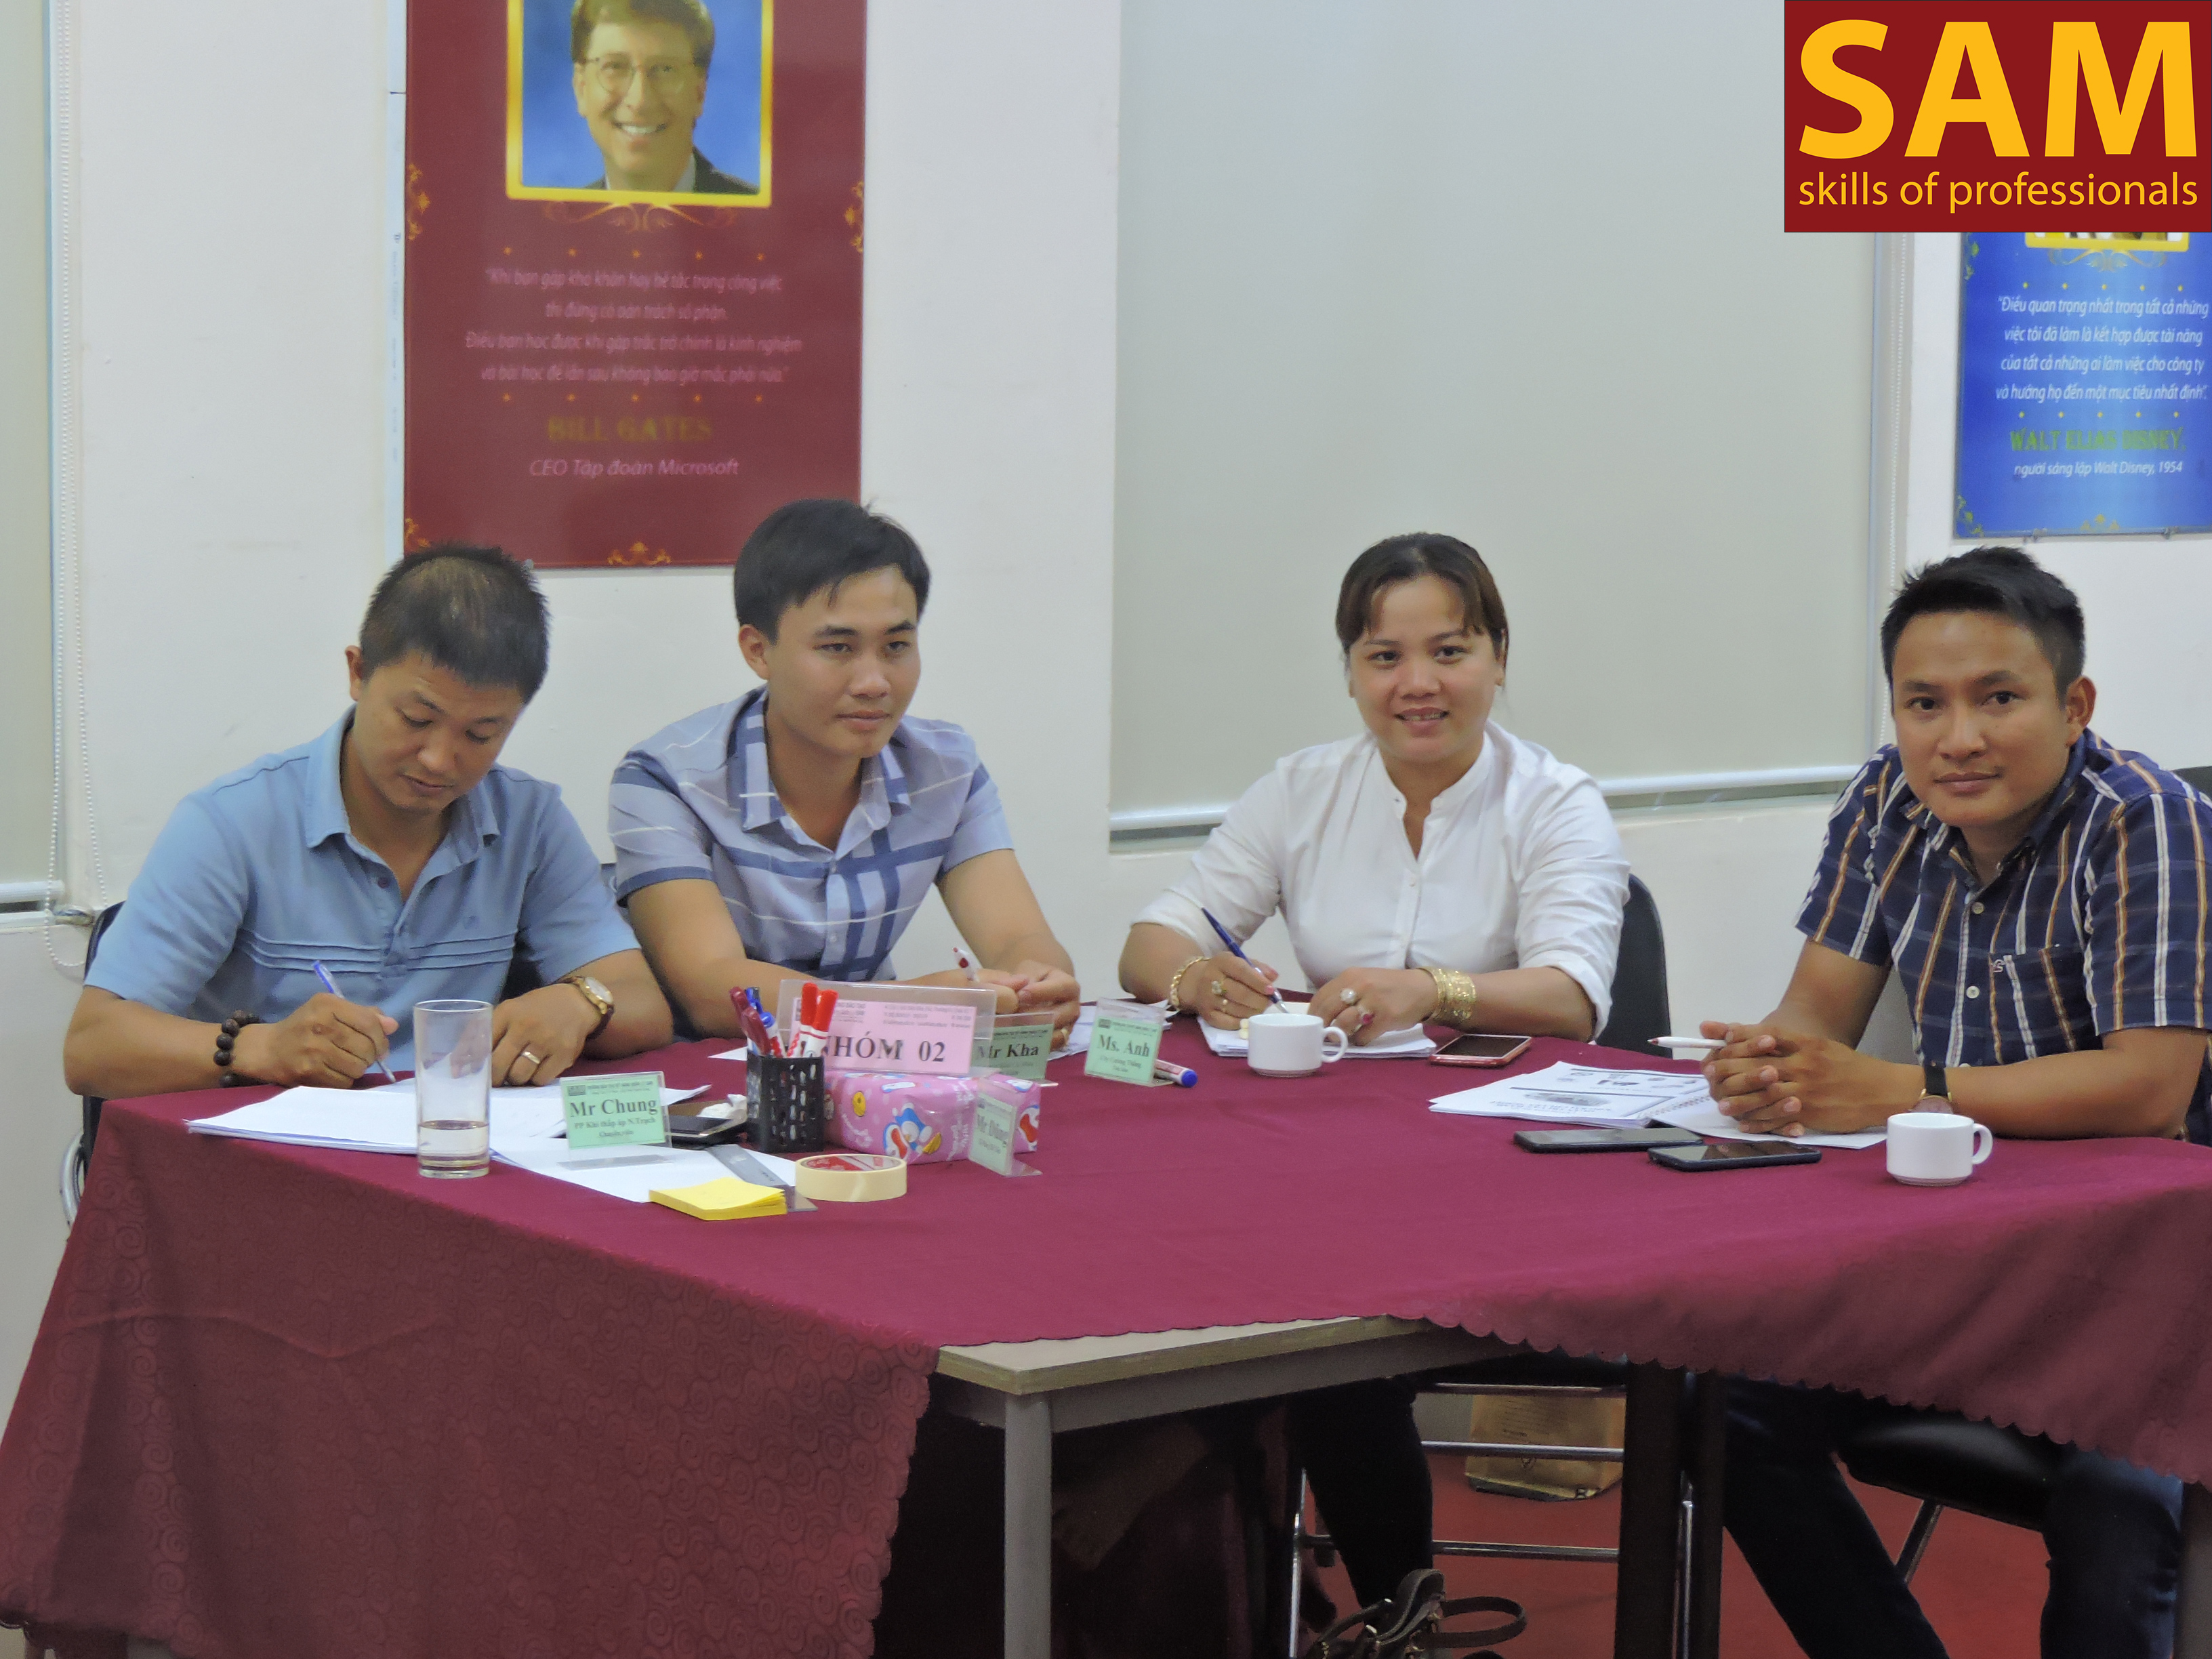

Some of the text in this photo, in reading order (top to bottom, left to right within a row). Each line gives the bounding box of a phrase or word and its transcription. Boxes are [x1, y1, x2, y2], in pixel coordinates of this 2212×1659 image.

[2028, 301, 2057, 316] quan
[2058, 300, 2087, 317] trọng
[2089, 297, 2114, 314] nhất
[2115, 300, 2144, 318] trong
[2145, 297, 2161, 314] tất
[2004, 325, 2026, 344] việc
[2027, 325, 2043, 342] tôi
[2059, 325, 2080, 342] làm
[2081, 325, 2092, 342] là
[2093, 325, 2110, 342] kết
[2133, 327, 2159, 346] được
[2001, 353, 2022, 371] của
[2022, 353, 2039, 371] tất
[2039, 353, 2053, 371] cả
[2054, 354, 2089, 375] những
[2090, 356, 2102, 371] ai
[2102, 354, 2123, 371] làm
[2125, 355, 2146, 375] việc
[2146, 355, 2166, 371] cho
[2194, 359, 2205, 375] ty
[2047, 384, 2062, 403] họ
[2063, 382, 2084, 400] đến
[2085, 384, 2108, 403] một
[2108, 388, 2132, 403] mục
[2133, 384, 2153, 400] tiêu
[2154, 384, 2179, 400] nhất
[2010, 428, 2061, 451] WALT
[2065, 430, 2116, 450] ELIAS
[529, 459, 568, 476] CEO
[657, 457, 741, 476] Microsoft
[2047, 461, 2073, 478] sáng
[2094, 461, 2118, 474] Walt
[2119, 461, 2154, 476] Disney,
[2158, 461, 2183, 474] 1954
[822, 1031, 946, 1062] HÓM 02
[1006, 1043, 1039, 1058] Kha
[1097, 1034, 1151, 1057] Ms. Anh
[570, 1099, 657, 1118] Mr Chung
